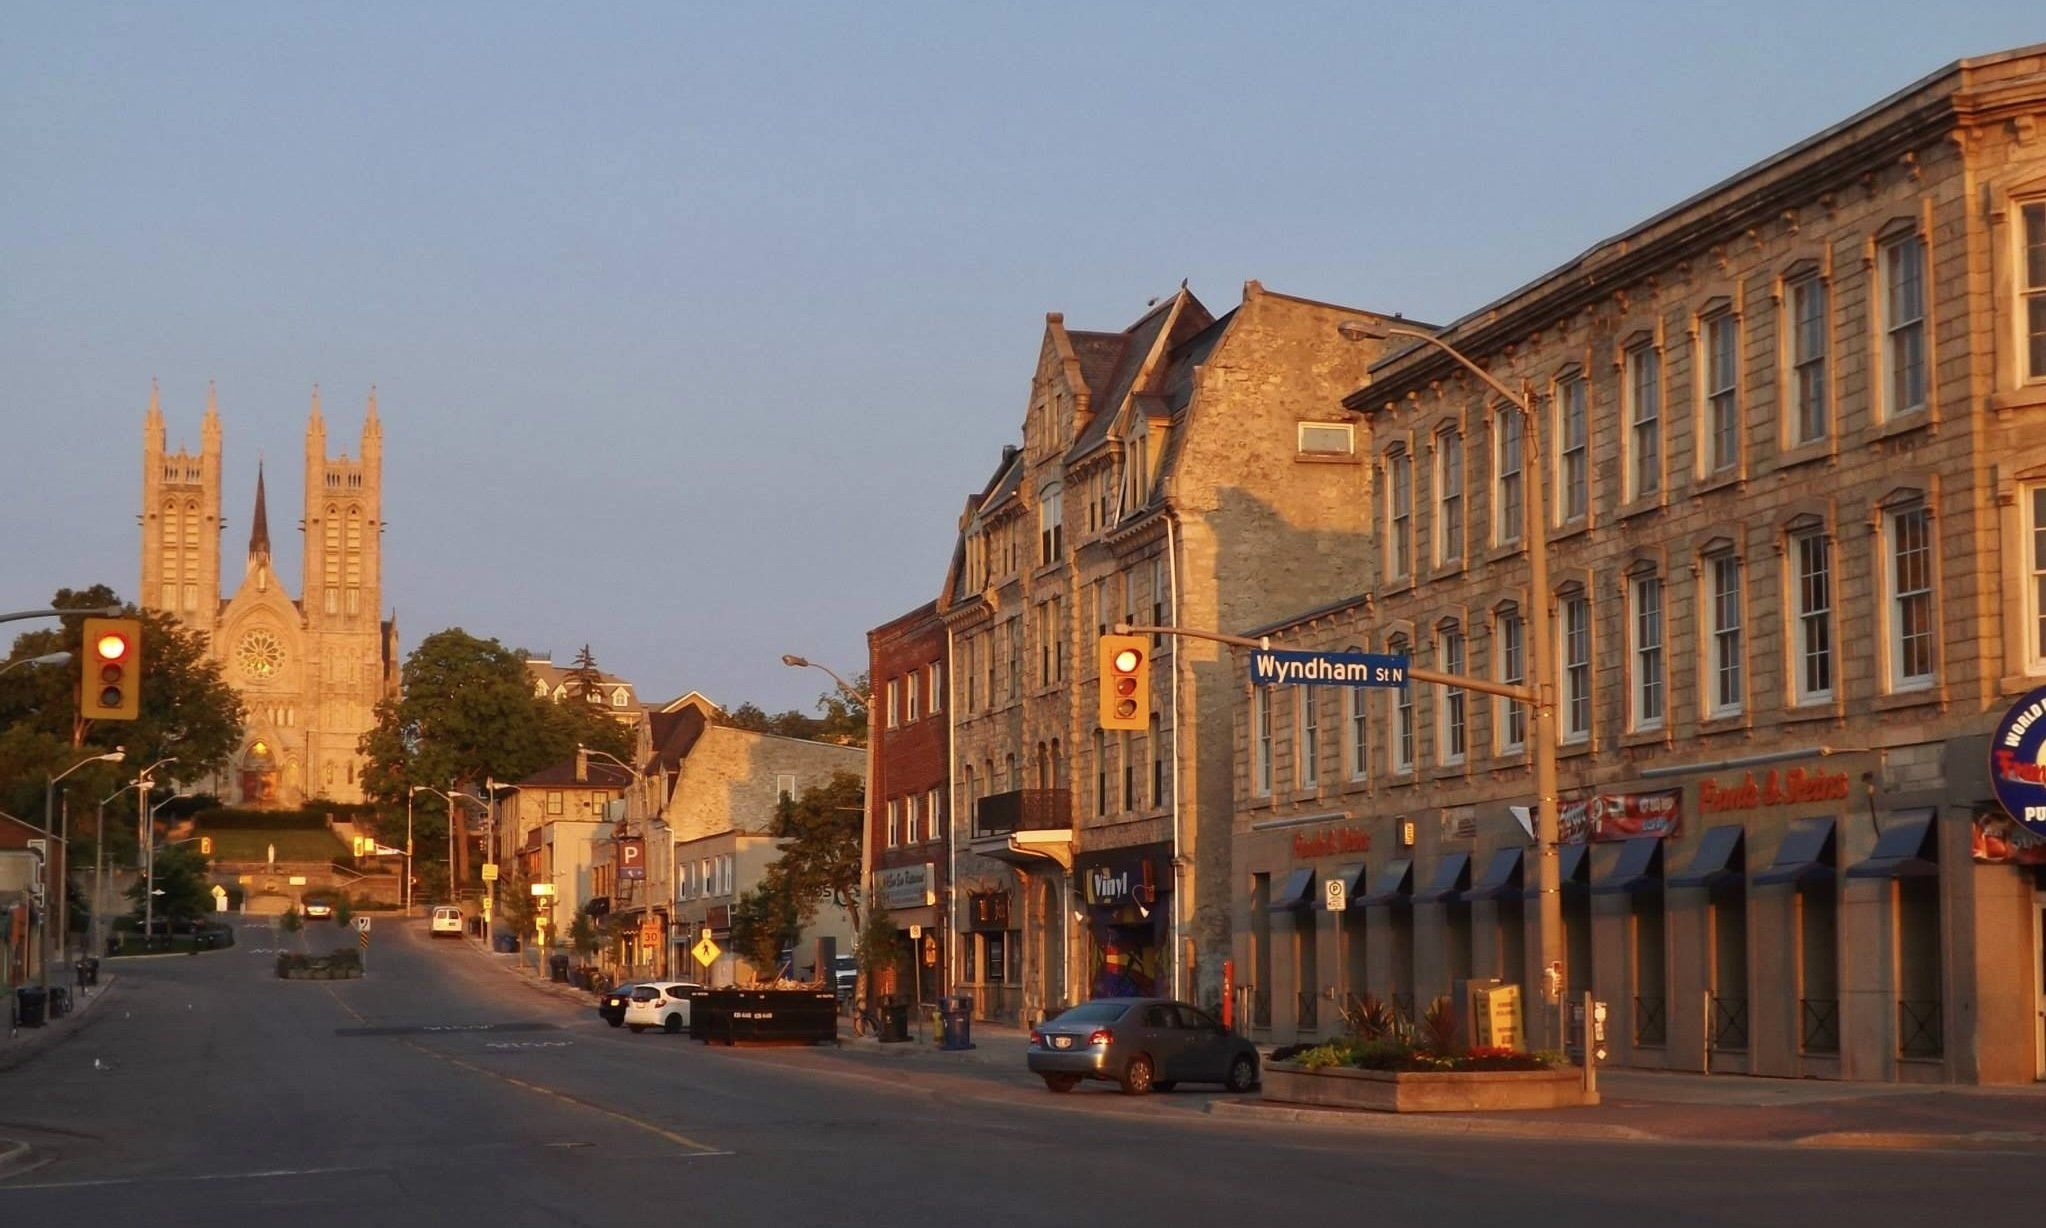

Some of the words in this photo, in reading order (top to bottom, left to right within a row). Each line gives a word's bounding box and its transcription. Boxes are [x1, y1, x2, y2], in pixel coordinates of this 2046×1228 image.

[1257, 654, 1368, 684] Wyndham
[1375, 667, 1390, 682] St
[1392, 668, 1403, 683] N
[2004, 702, 2043, 748] WORLD
[624, 846, 638, 864] P
[1094, 871, 1128, 900] Vinyl
[644, 932, 658, 942] 30
